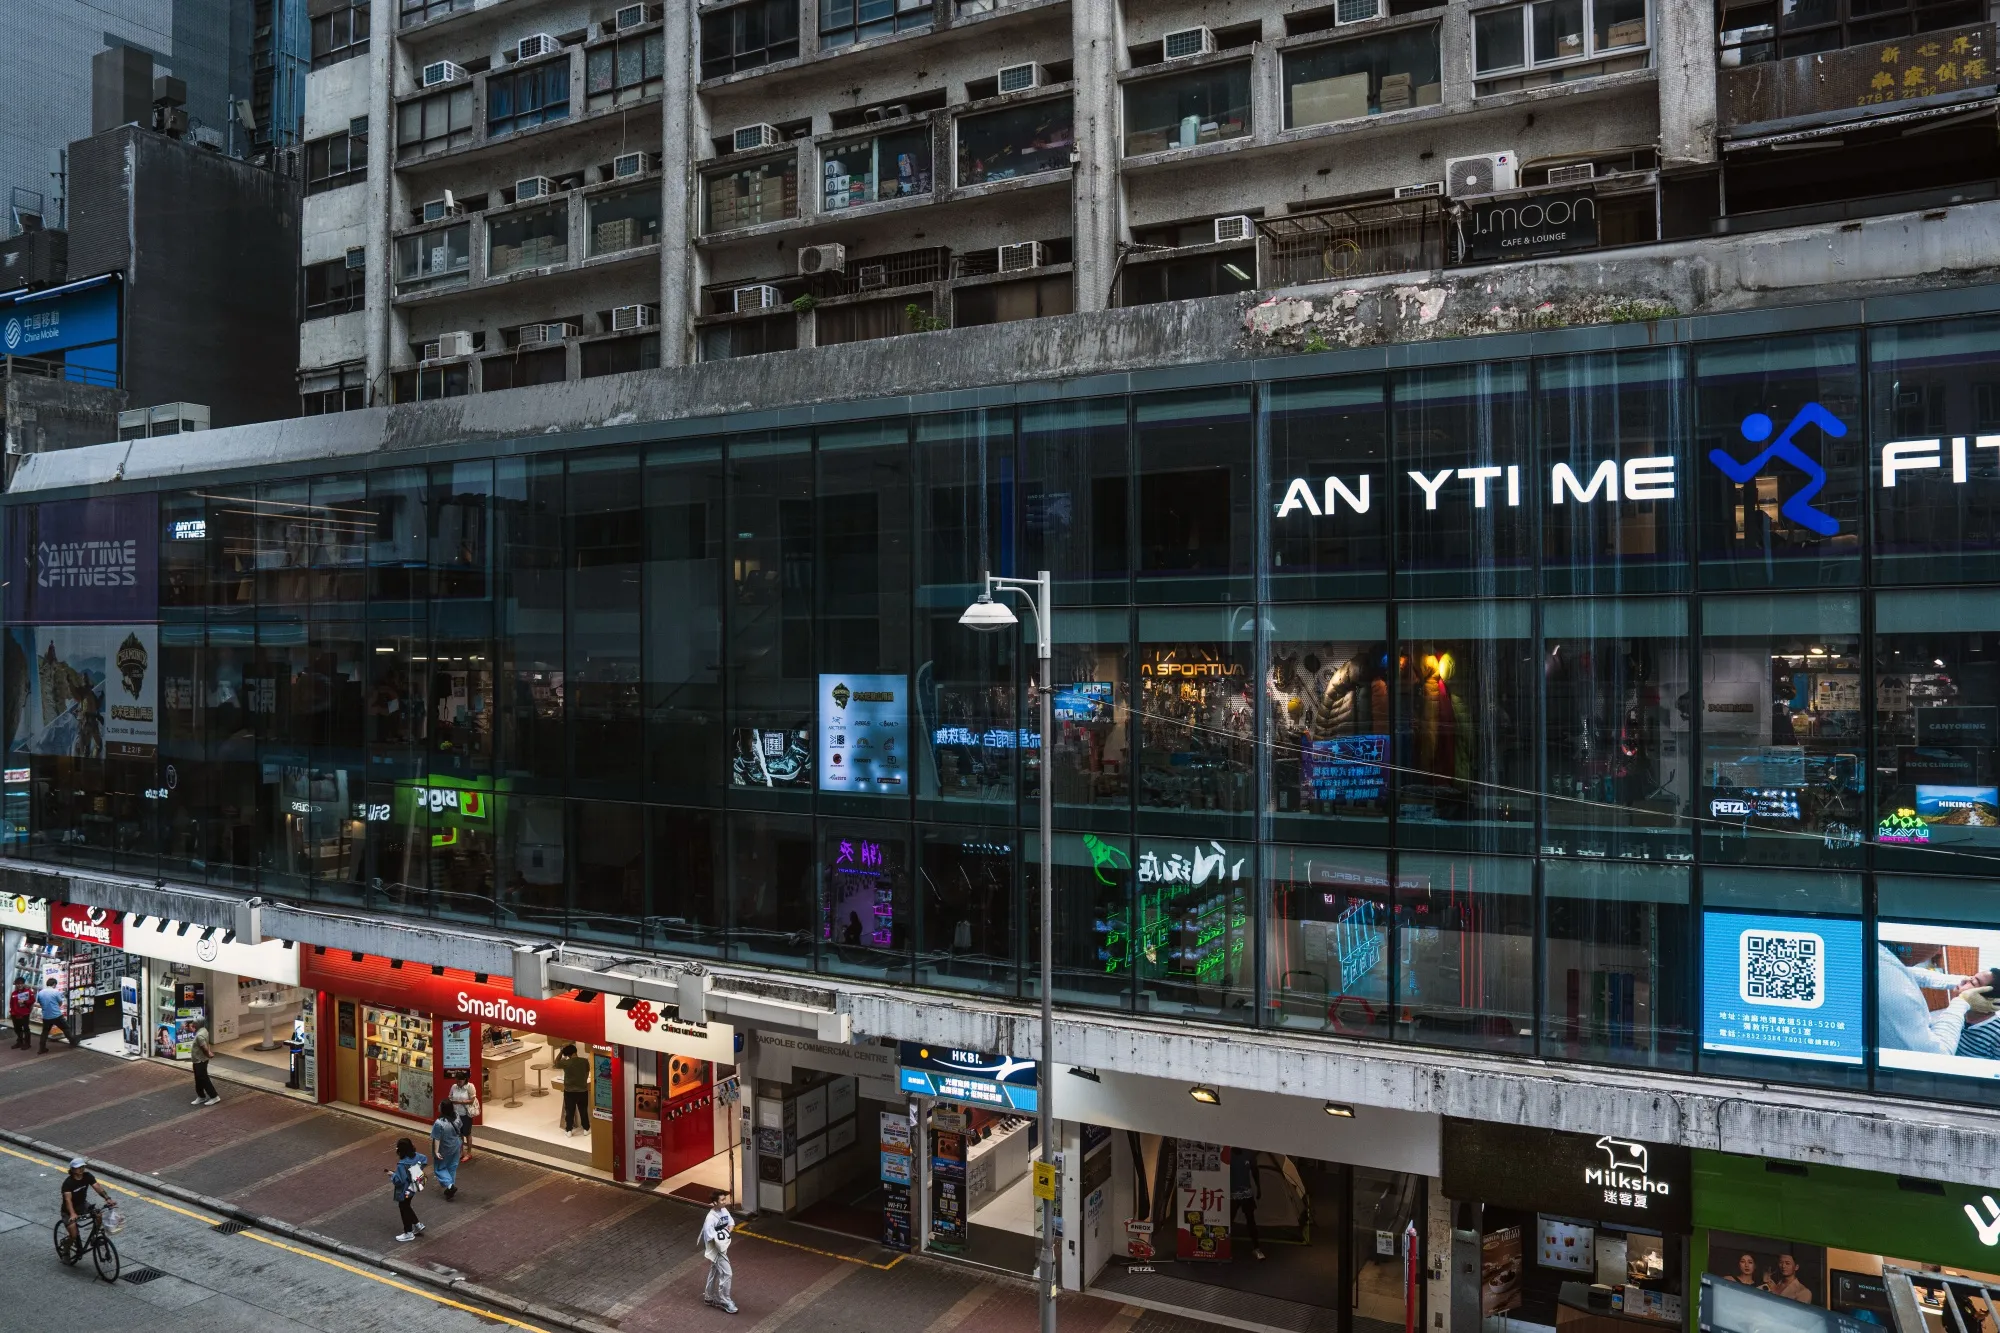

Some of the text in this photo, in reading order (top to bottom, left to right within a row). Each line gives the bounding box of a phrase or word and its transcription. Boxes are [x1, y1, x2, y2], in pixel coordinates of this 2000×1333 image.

[1501, 232, 1567, 248] CAFE & LOUNGE
[24, 327, 60, 343] China Mobile
[48, 539, 136, 568] ANYTIME
[49, 565, 136, 588] FITNESS
[1157, 662, 1245, 677] SPORTIVA
[1711, 801, 1750, 818] PETZL
[1938, 800, 1974, 809] HIKING
[1878, 826, 1929, 838] KAVU
[457, 991, 537, 1026] SmarTone
[661, 1023, 708, 1039] China unicom
[755, 1035, 889, 1064] PAKPOLEE COMMERCIAL CENTRE
[1585, 1167, 1670, 1196] Milksha
[1183, 1187, 1225, 1213] 7折
[1604, 1189, 1649, 1210] 迷客夏
